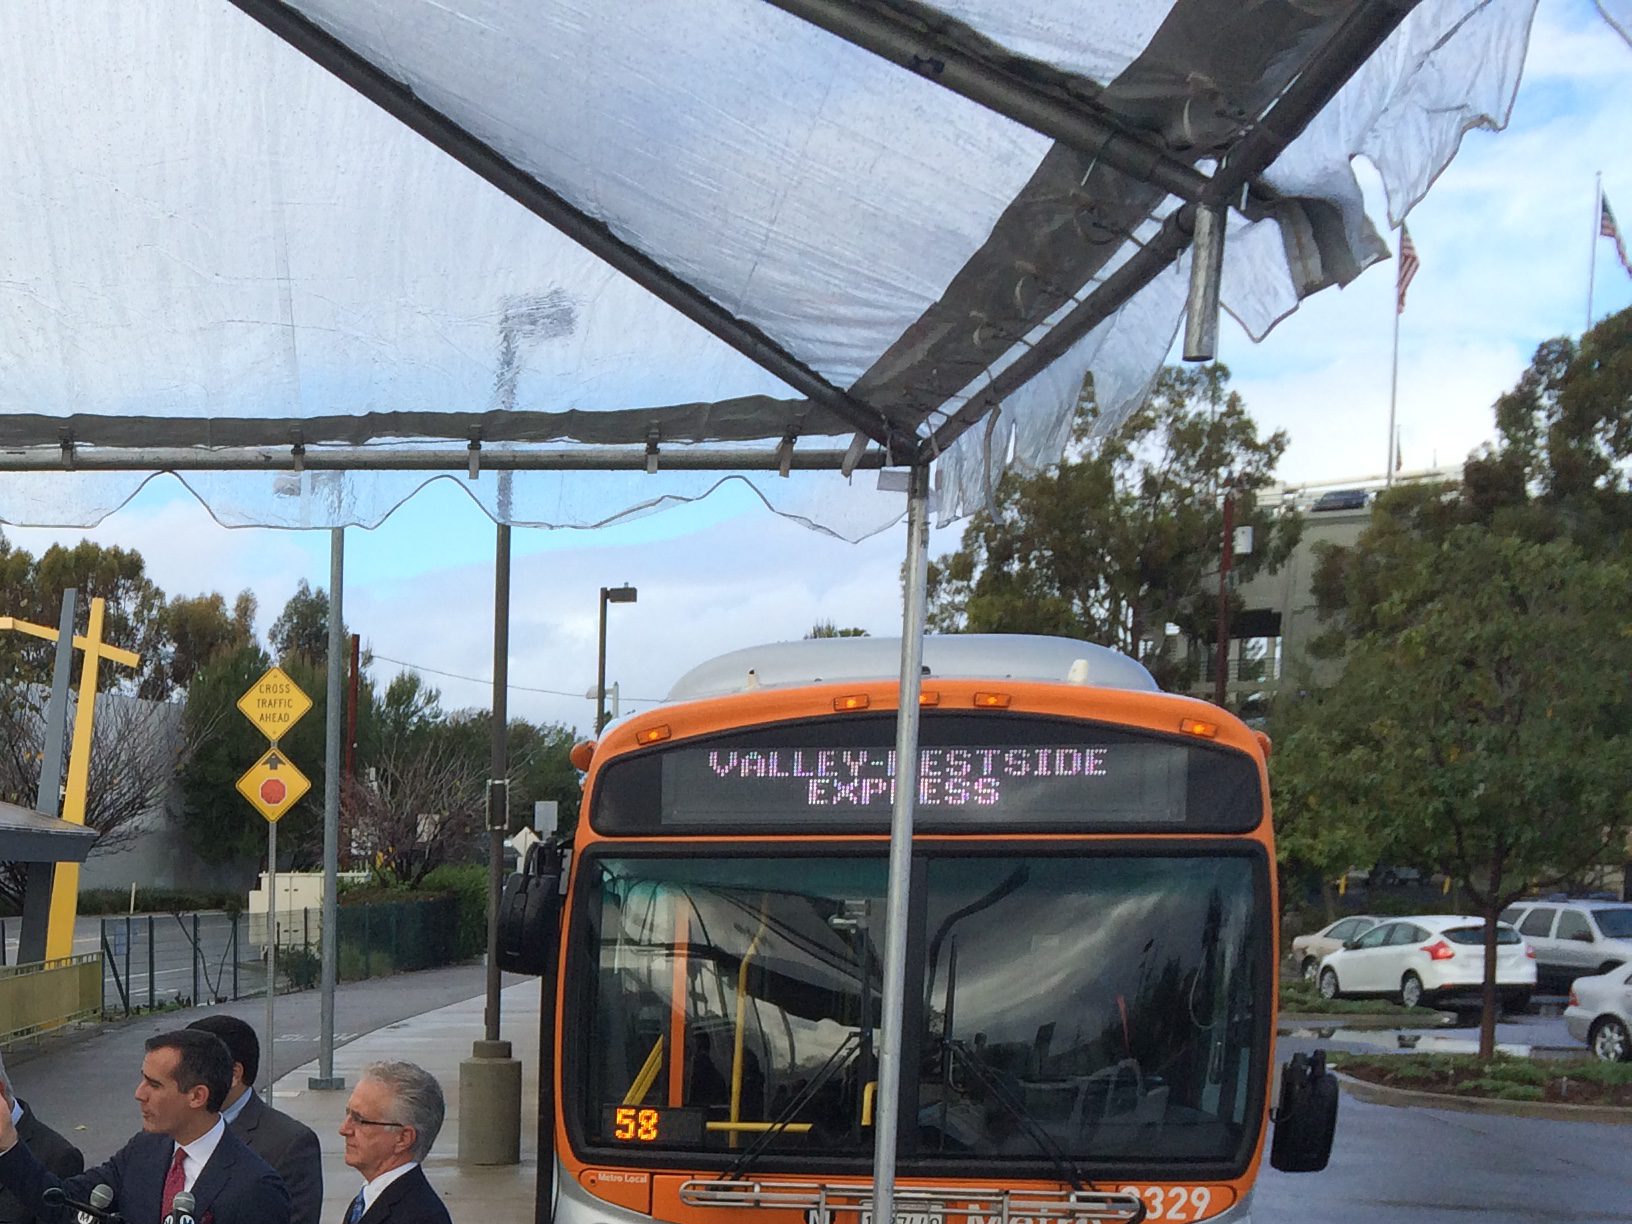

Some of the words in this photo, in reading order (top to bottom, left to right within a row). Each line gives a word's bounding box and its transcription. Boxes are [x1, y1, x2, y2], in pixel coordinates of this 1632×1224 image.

[259, 683, 290, 694] CROSS
[257, 698, 293, 708] TRAFFIC
[259, 713, 290, 723] AHEAD
[615, 1108, 658, 1140] 58
